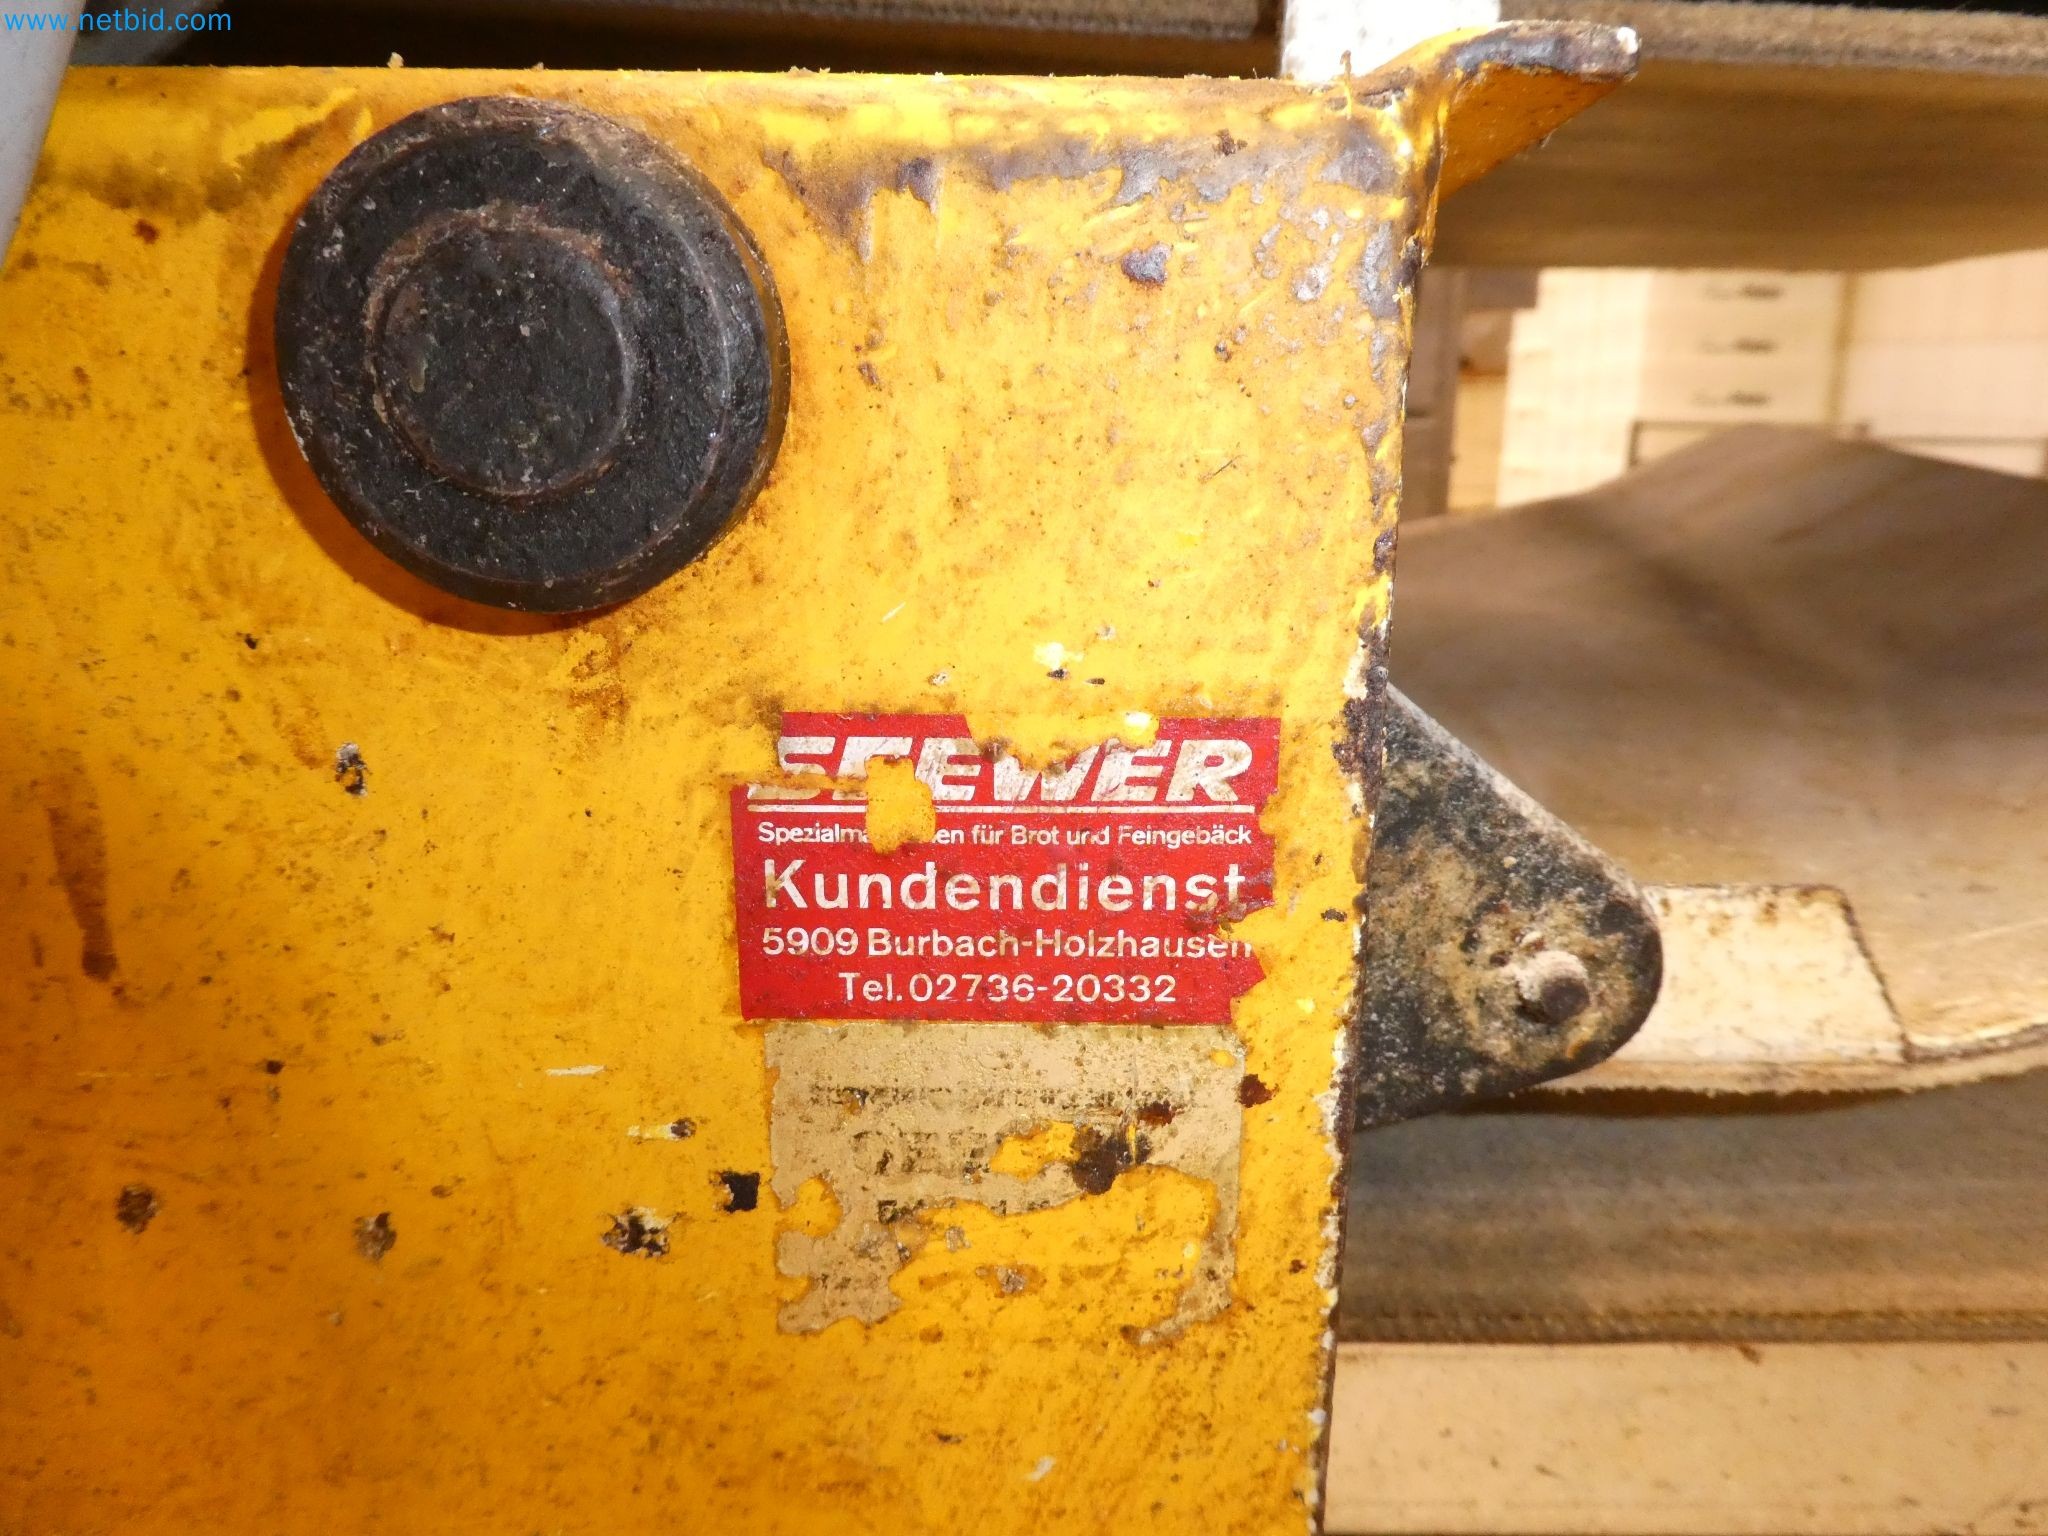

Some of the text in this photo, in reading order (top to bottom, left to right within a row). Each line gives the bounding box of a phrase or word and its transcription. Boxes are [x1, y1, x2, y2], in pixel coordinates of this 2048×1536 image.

[758, 821, 1252, 849] Spezialmen für Brot und Feingebäck
[764, 858, 1247, 912] Kundendienst
[762, 927, 1253, 958] 5909 Burbach-Holzhausen
